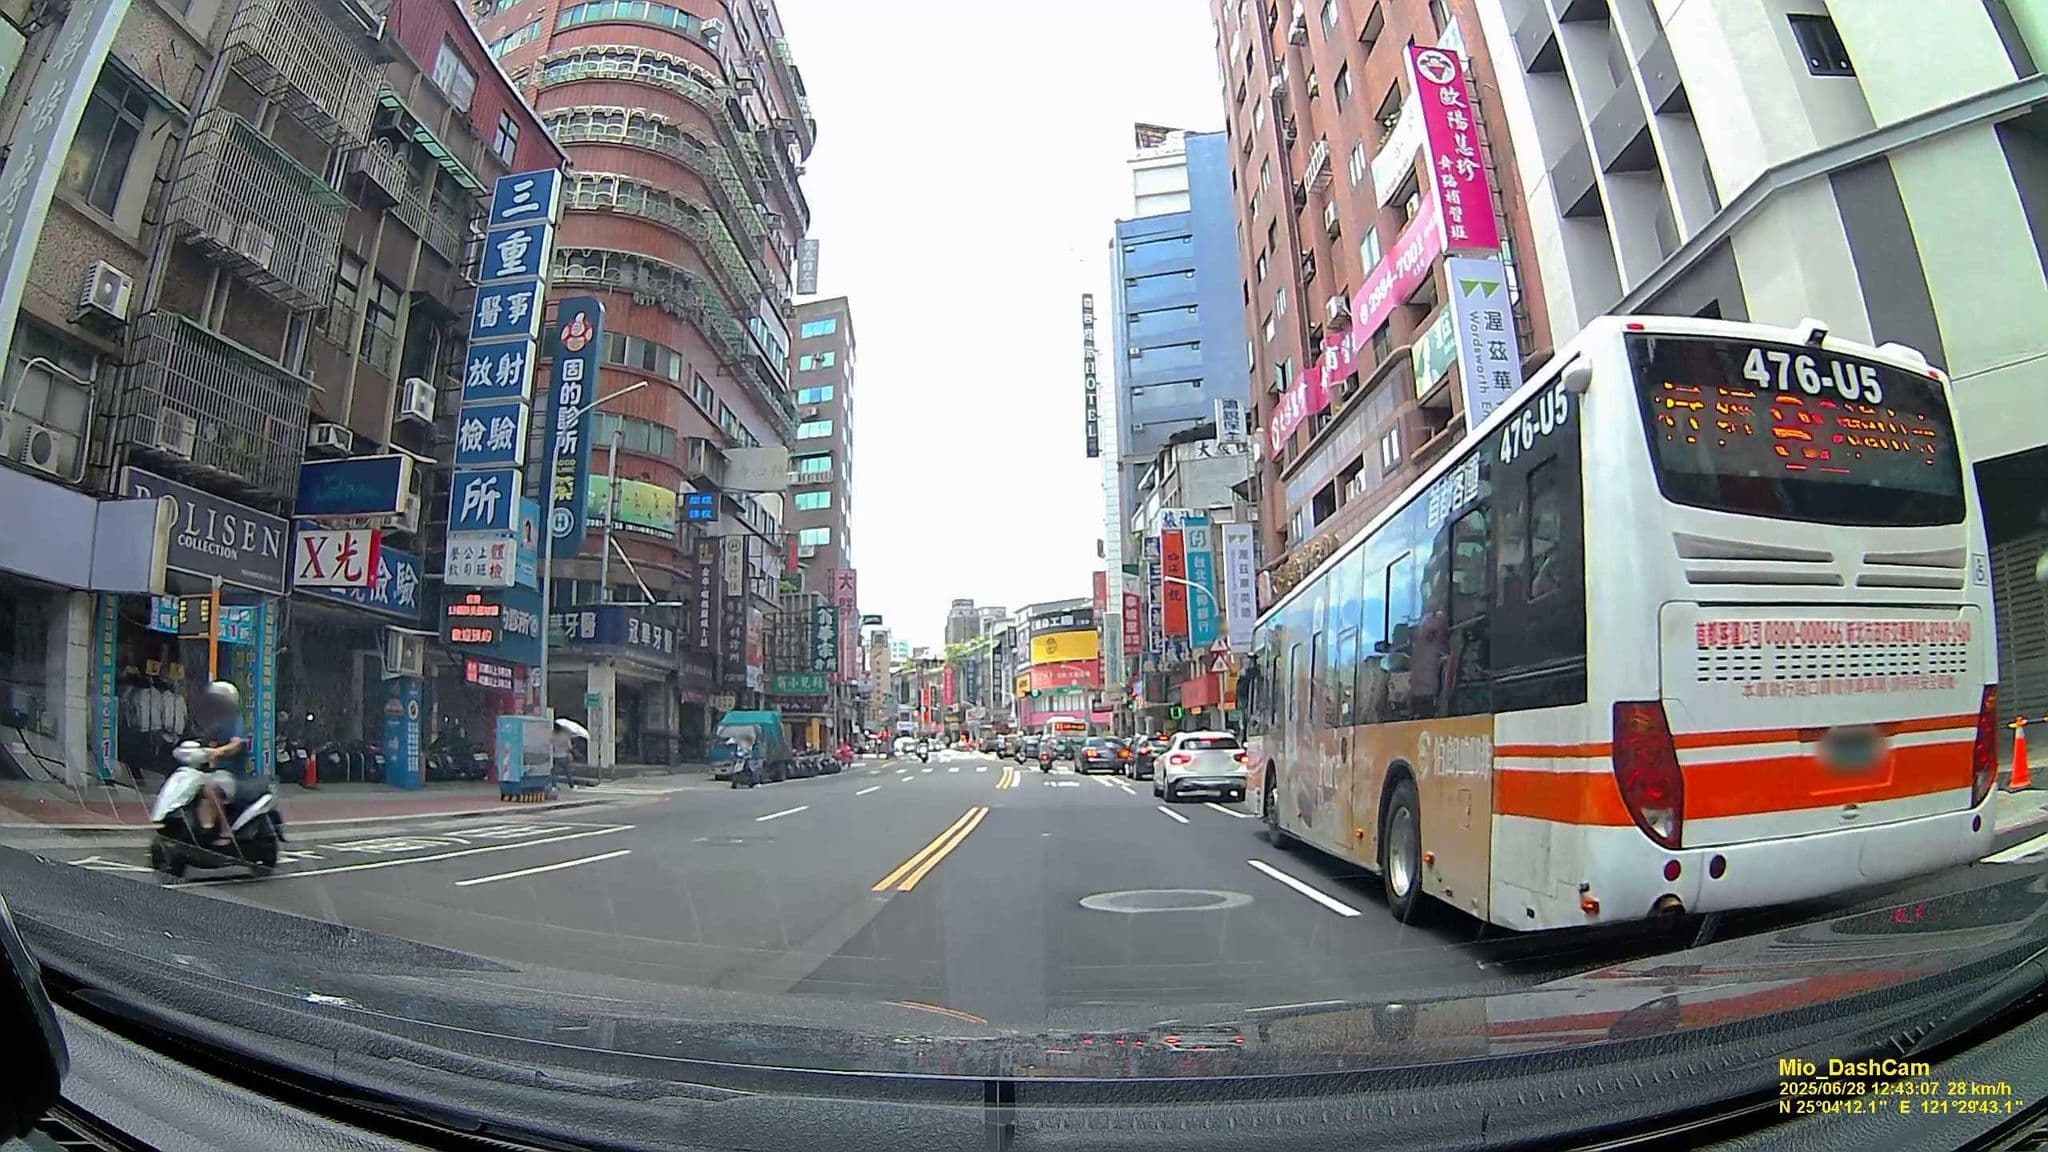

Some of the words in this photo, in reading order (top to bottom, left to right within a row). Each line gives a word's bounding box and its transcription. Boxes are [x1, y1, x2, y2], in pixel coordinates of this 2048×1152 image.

[1469, 311, 1490, 394] Wordsworth
[1483, 310, 1513, 406] 渥茲華
[1743, 348, 1882, 404] 476-U5
[1499, 383, 1570, 464] 476-U5
[177, 533, 238, 561] COLLECTION
[300, 531, 362, 581] X光
